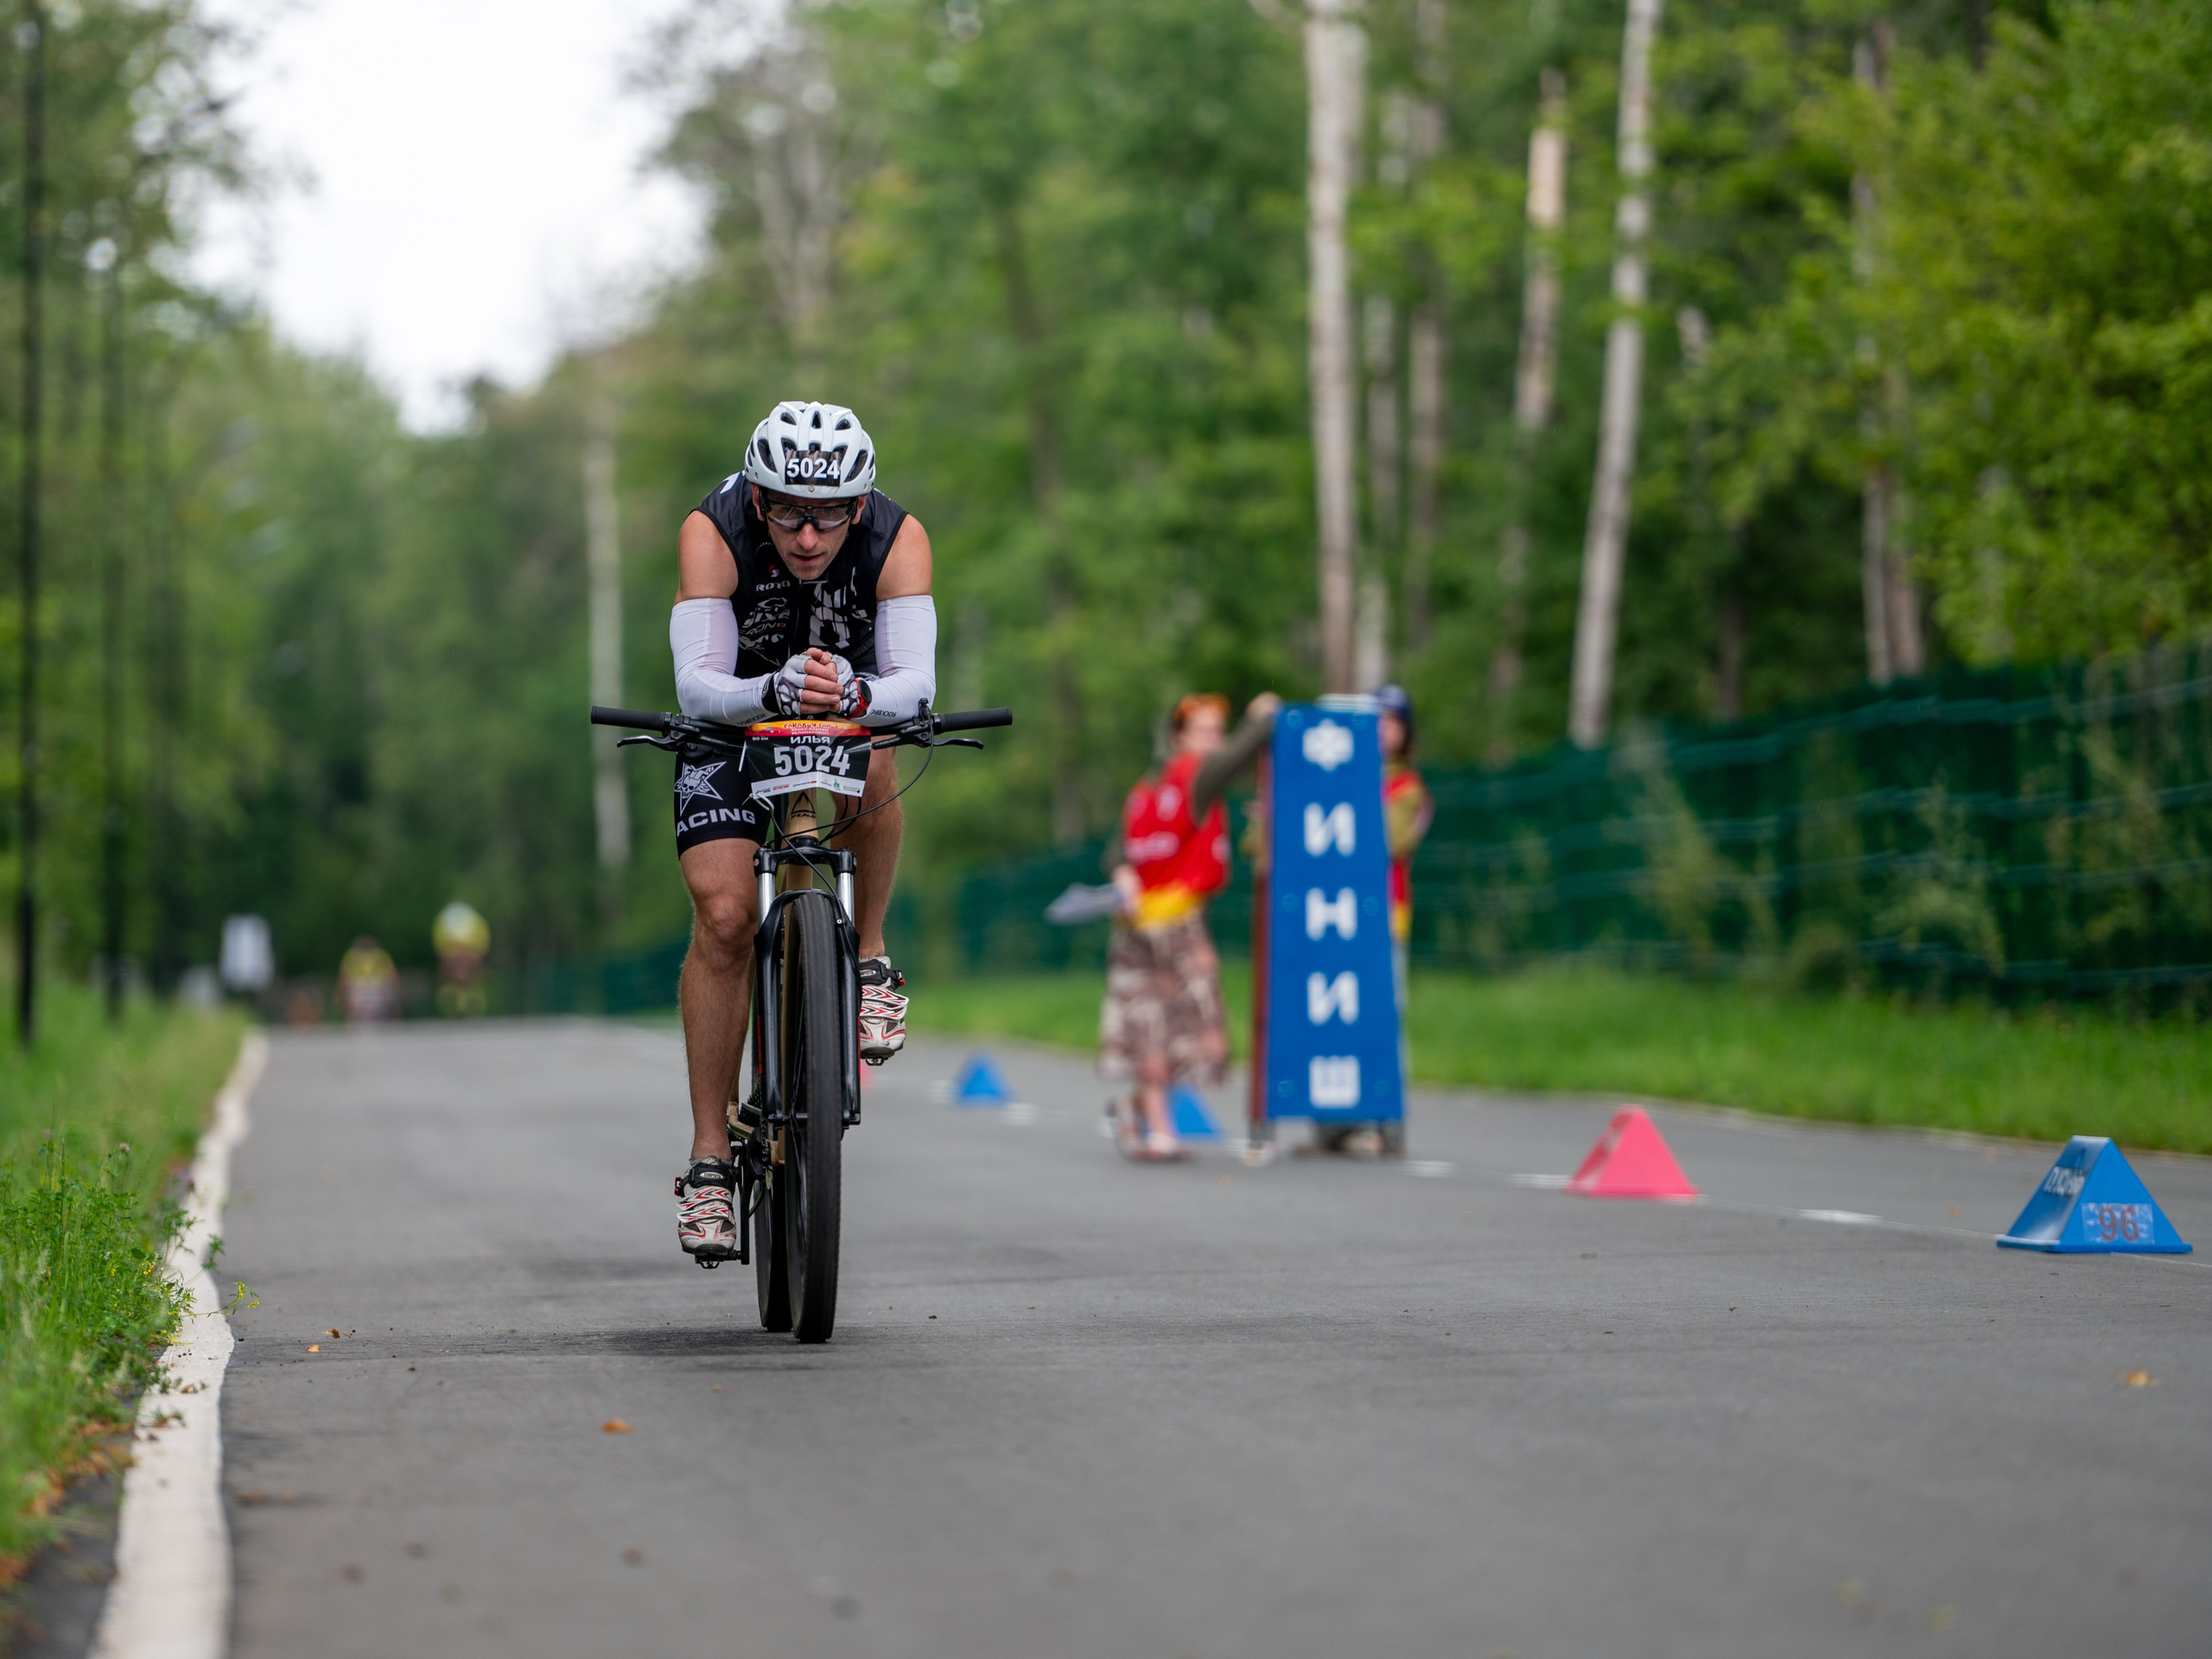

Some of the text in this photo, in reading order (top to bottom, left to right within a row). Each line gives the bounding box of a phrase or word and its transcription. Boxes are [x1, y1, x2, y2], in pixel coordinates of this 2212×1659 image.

[786, 457, 840, 480] 5024
[790, 735, 830, 744] ИЛЬЯ
[773, 745, 851, 776] 5024
[1302, 718, 1362, 1109] ФИНИШ
[2098, 1205, 2139, 1242] 96
